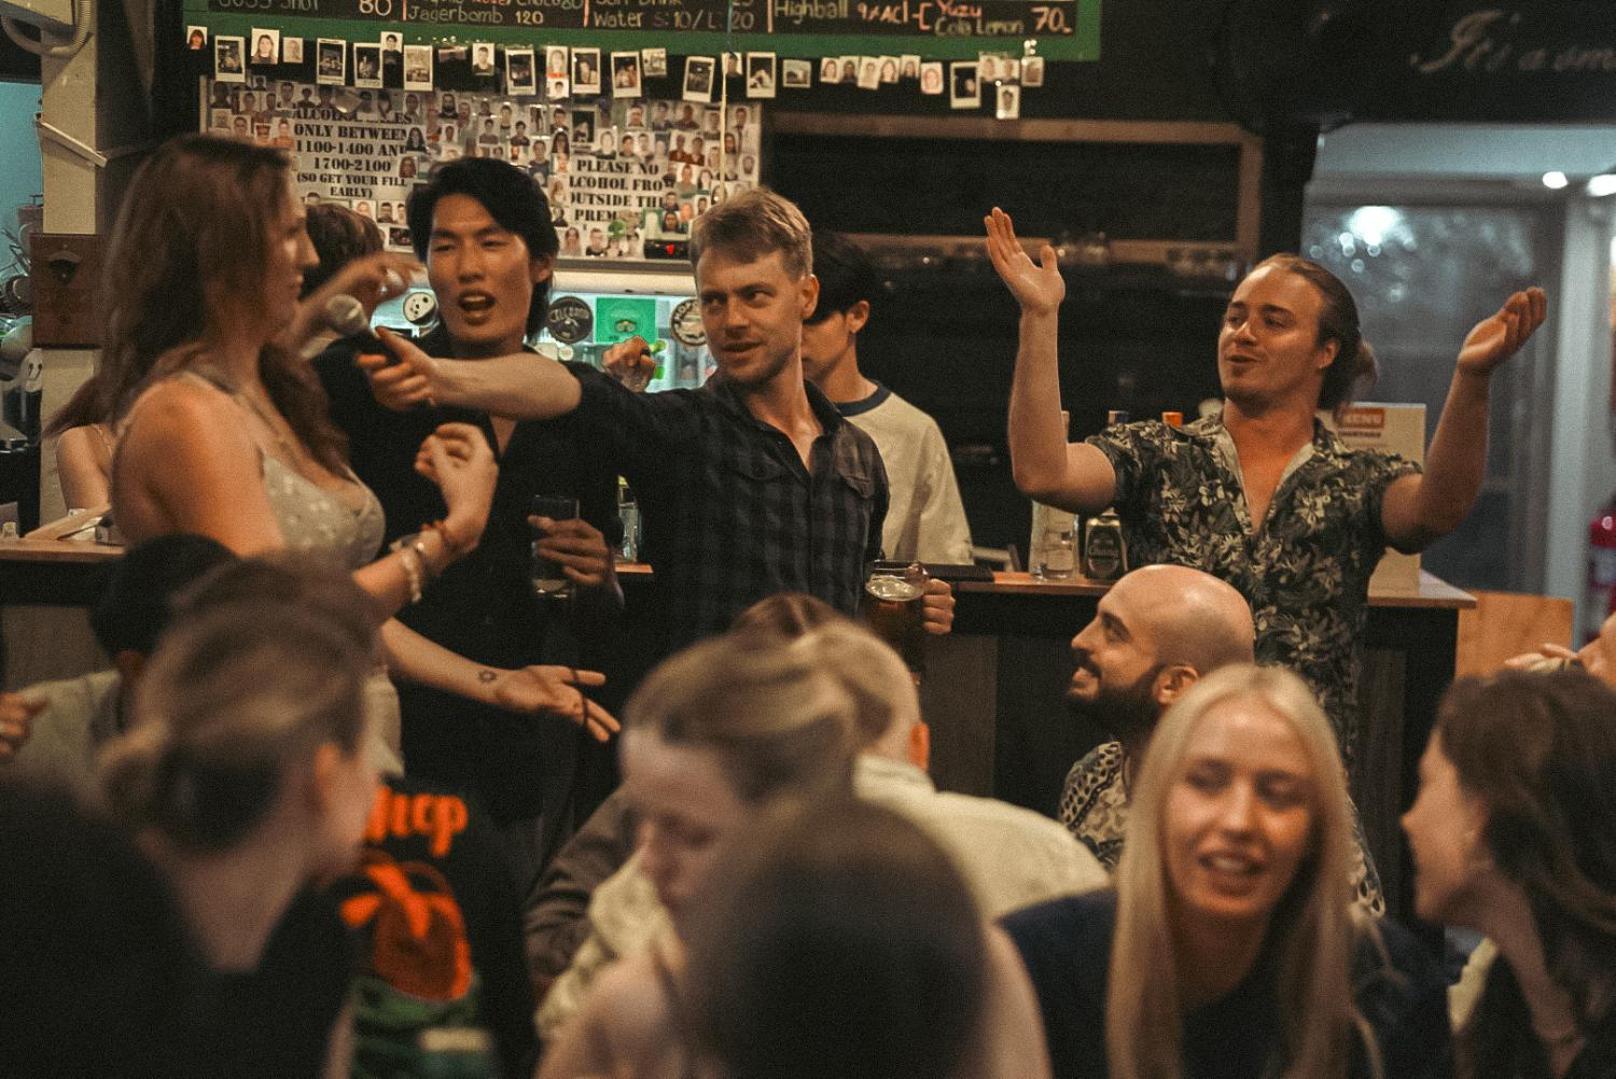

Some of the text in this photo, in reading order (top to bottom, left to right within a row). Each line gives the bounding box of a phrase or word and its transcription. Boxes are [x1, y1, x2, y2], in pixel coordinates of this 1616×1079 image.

[408, 5, 544, 24] Jagerbomb 120
[593, 11, 643, 27] Water
[773, 0, 849, 24] Highball
[294, 124, 407, 140] ONLY BETWEEN
[296, 140, 374, 155] 1100-1400
[314, 157, 391, 171] 1700-2100
[577, 159, 659, 175] PLEASE NO
[297, 172, 408, 187] (SO GET YOUR FILL
[569, 175, 663, 191] LCOHOL FRO
[330, 187, 373, 198] EARLY)
